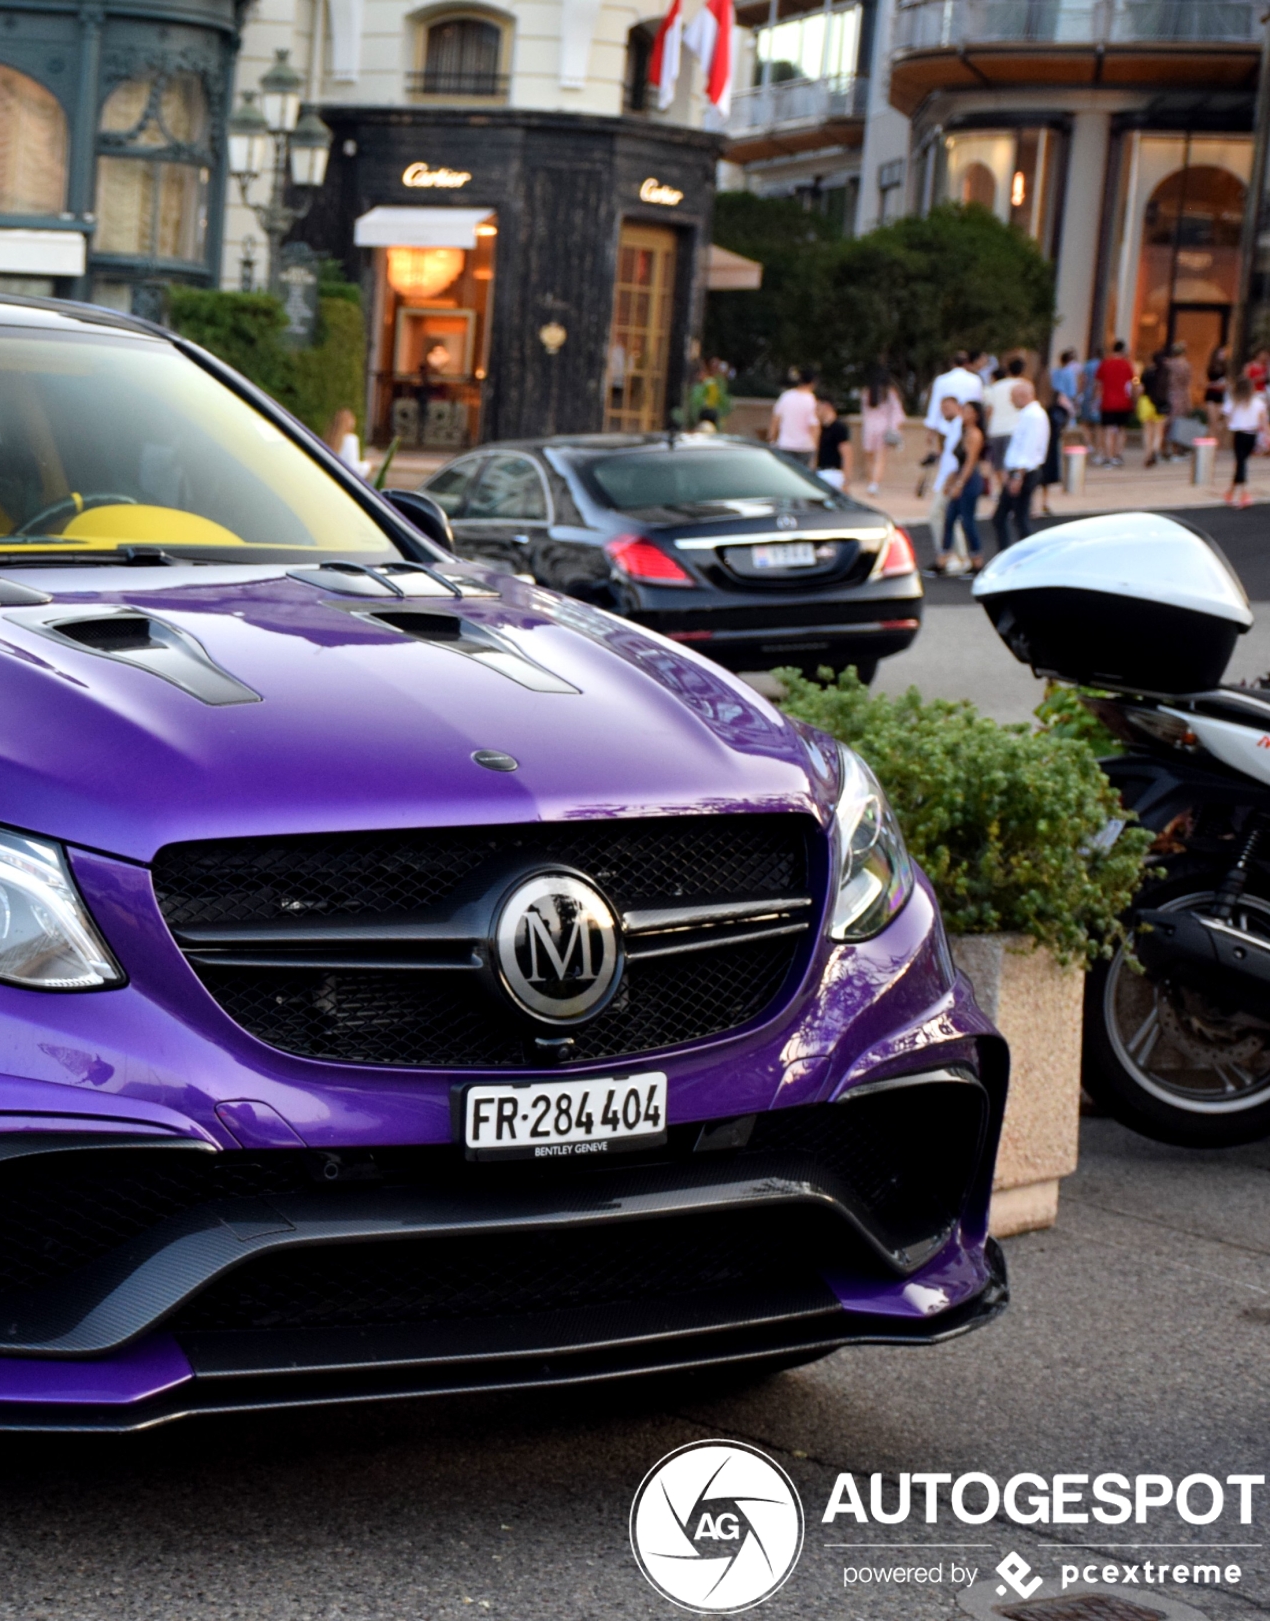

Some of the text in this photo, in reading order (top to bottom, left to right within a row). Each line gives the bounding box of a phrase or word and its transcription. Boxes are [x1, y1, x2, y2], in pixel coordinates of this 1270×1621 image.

[403, 162, 471, 188] Cartier
[521, 911, 598, 983] M
[534, 1141, 608, 1157] BENTLEY GENEVE
